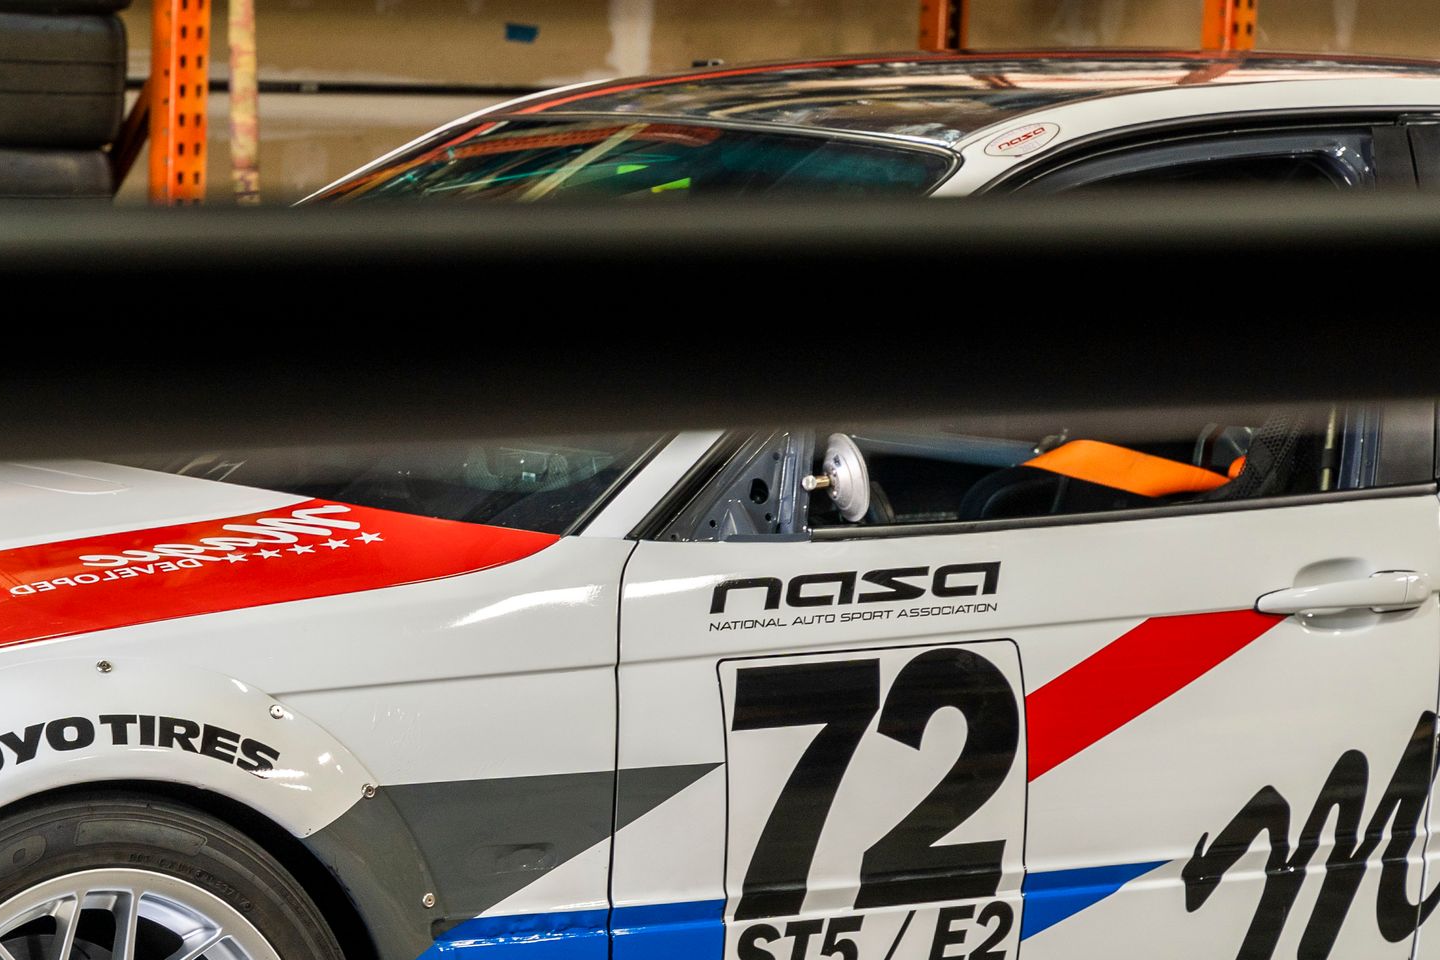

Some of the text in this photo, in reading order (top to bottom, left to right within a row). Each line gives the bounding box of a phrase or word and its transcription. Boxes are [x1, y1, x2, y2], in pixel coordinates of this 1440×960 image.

[998, 127, 1046, 150] nasa
[709, 561, 1002, 615] nasa
[709, 602, 998, 632] NATIONAL AUTO SPORT ASSOCIATION
[98, 714, 281, 778] TIRES
[731, 647, 1020, 922] 72
